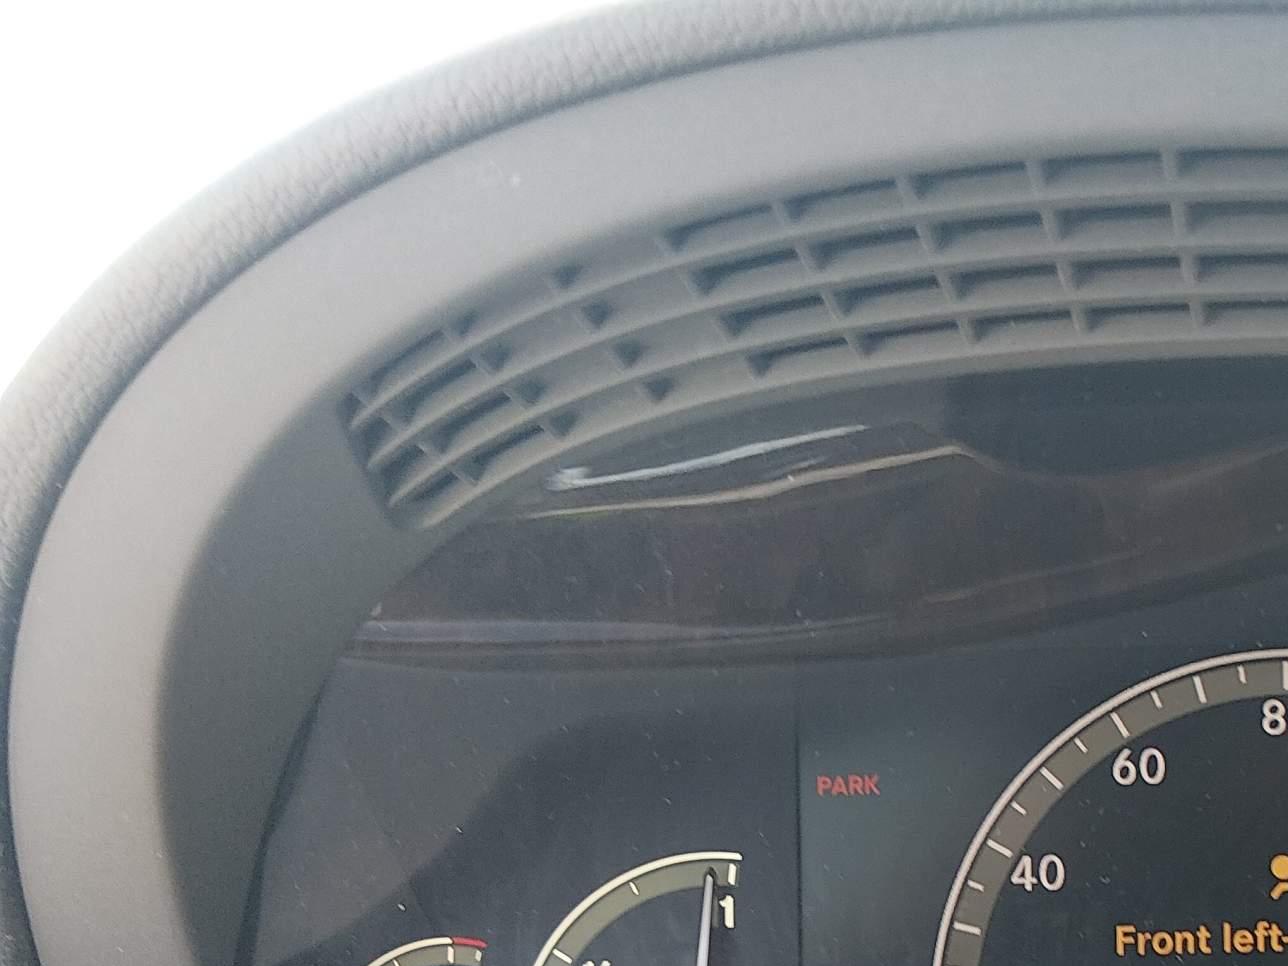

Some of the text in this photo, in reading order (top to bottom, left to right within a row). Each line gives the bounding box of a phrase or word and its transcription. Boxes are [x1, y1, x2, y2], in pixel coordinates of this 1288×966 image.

[1112, 747, 1166, 786] 60
[816, 774, 881, 796] PARK
[1007, 851, 1065, 892] 40
[720, 895, 736, 929] 1
[1115, 925, 1212, 956] Front
